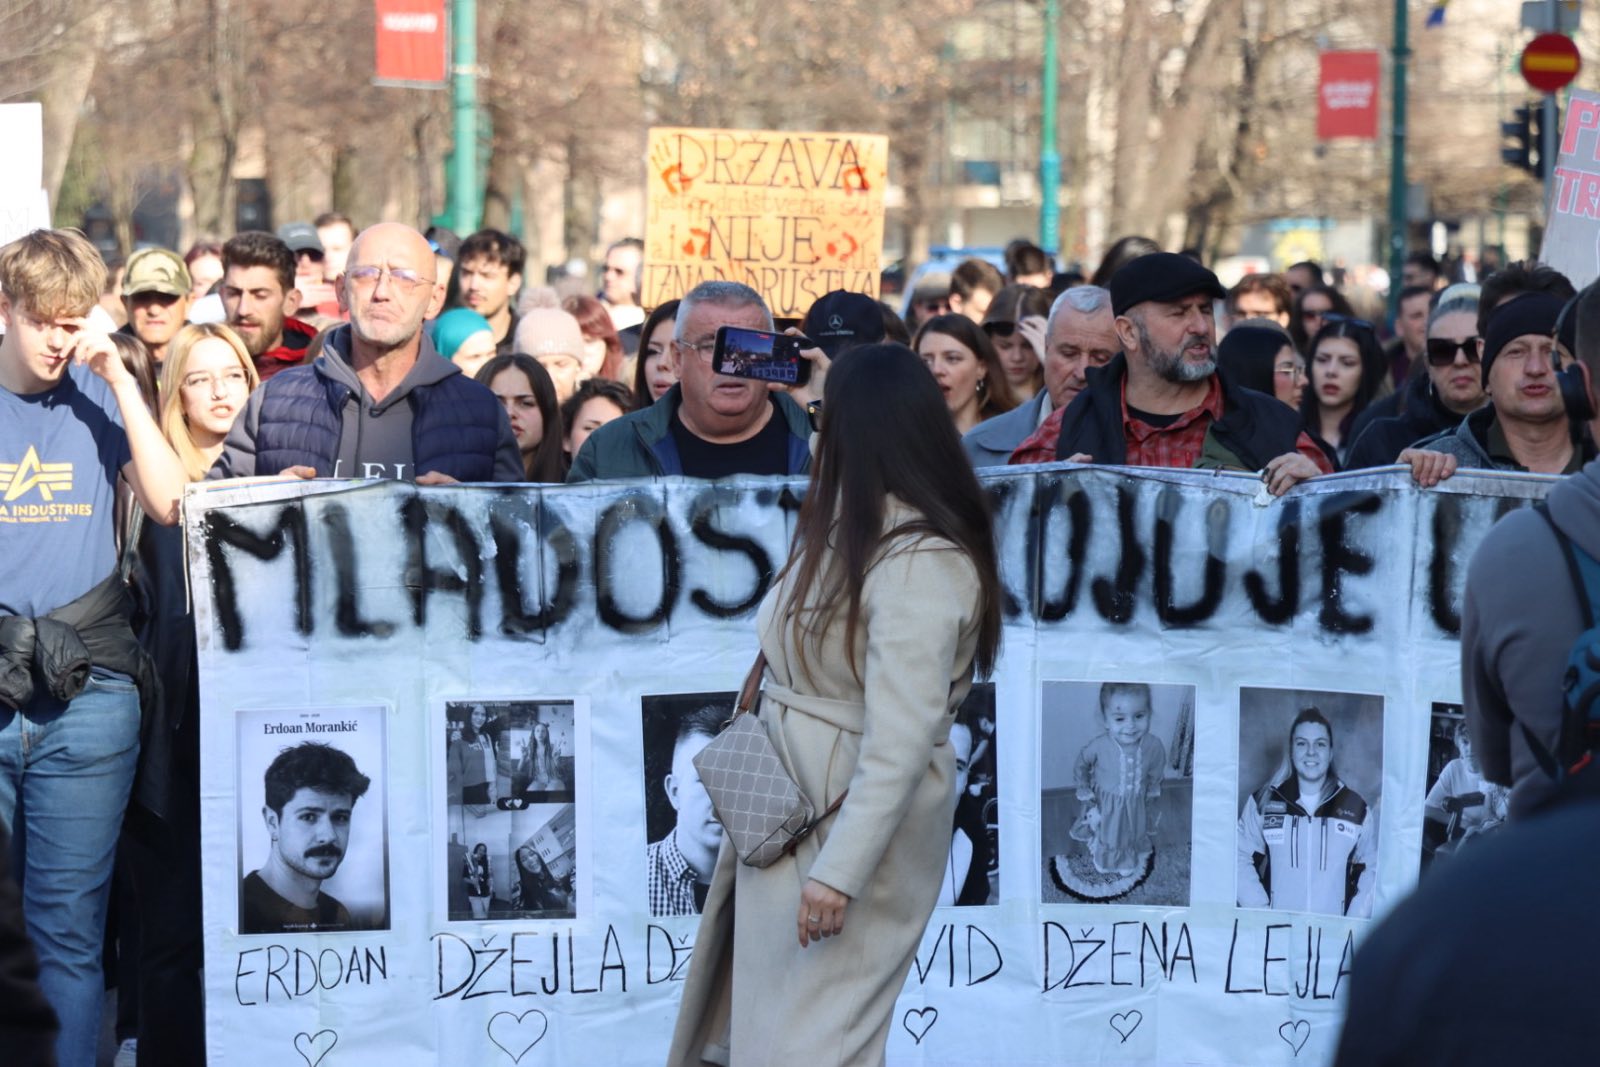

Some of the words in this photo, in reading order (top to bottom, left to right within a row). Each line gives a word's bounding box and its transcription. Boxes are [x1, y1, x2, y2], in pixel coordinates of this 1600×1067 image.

[1561, 95, 1600, 161] P
[672, 133, 869, 191] DRŽAVA
[1554, 168, 1600, 219] TR
[704, 216, 823, 265] NIJE
[13, 503, 92, 517] INDUSTRIES
[263, 722, 303, 735] Erdoan
[305, 720, 358, 734] Morankić
[235, 944, 388, 1006] ERDOAN
[429, 924, 627, 1000] DŽEJLA
[646, 924, 694, 984] DŽ
[914, 923, 1003, 987] VID
[1041, 920, 1197, 994] DŽENA
